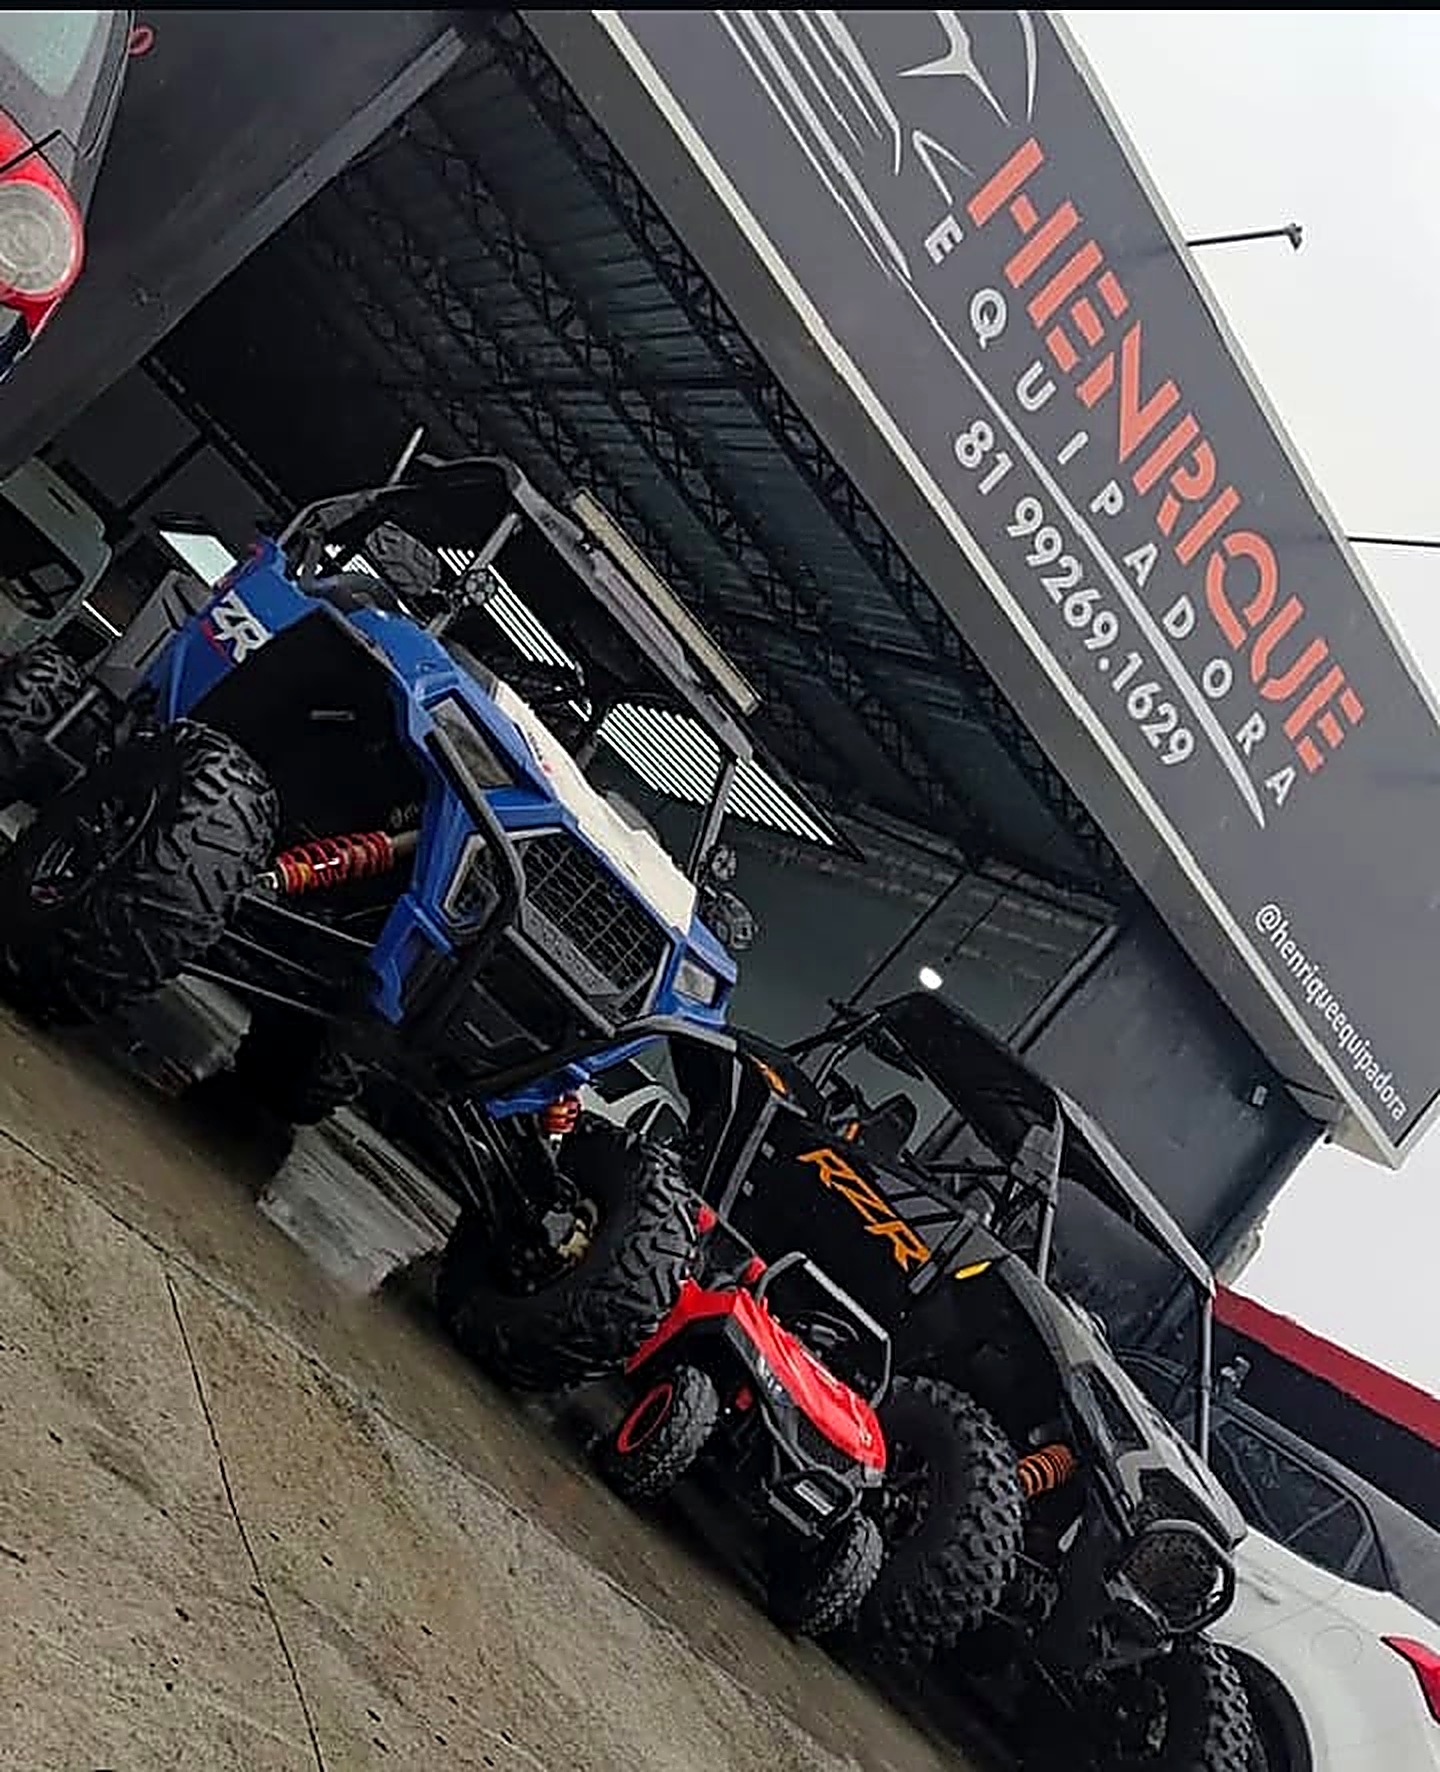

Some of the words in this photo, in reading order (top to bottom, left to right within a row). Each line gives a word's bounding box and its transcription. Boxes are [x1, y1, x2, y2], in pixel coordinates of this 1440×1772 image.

[924, 213, 1297, 806] EQUIPADORA
[953, 419, 1014, 495] 81
[1006, 496, 1195, 766] 99269.1629
[967, 138, 1364, 772] HENRIQUE
[209, 589, 275, 663] ZR
[1255, 904, 1407, 1121] @henriqueequipadora
[796, 1148, 930, 1273] RZR
